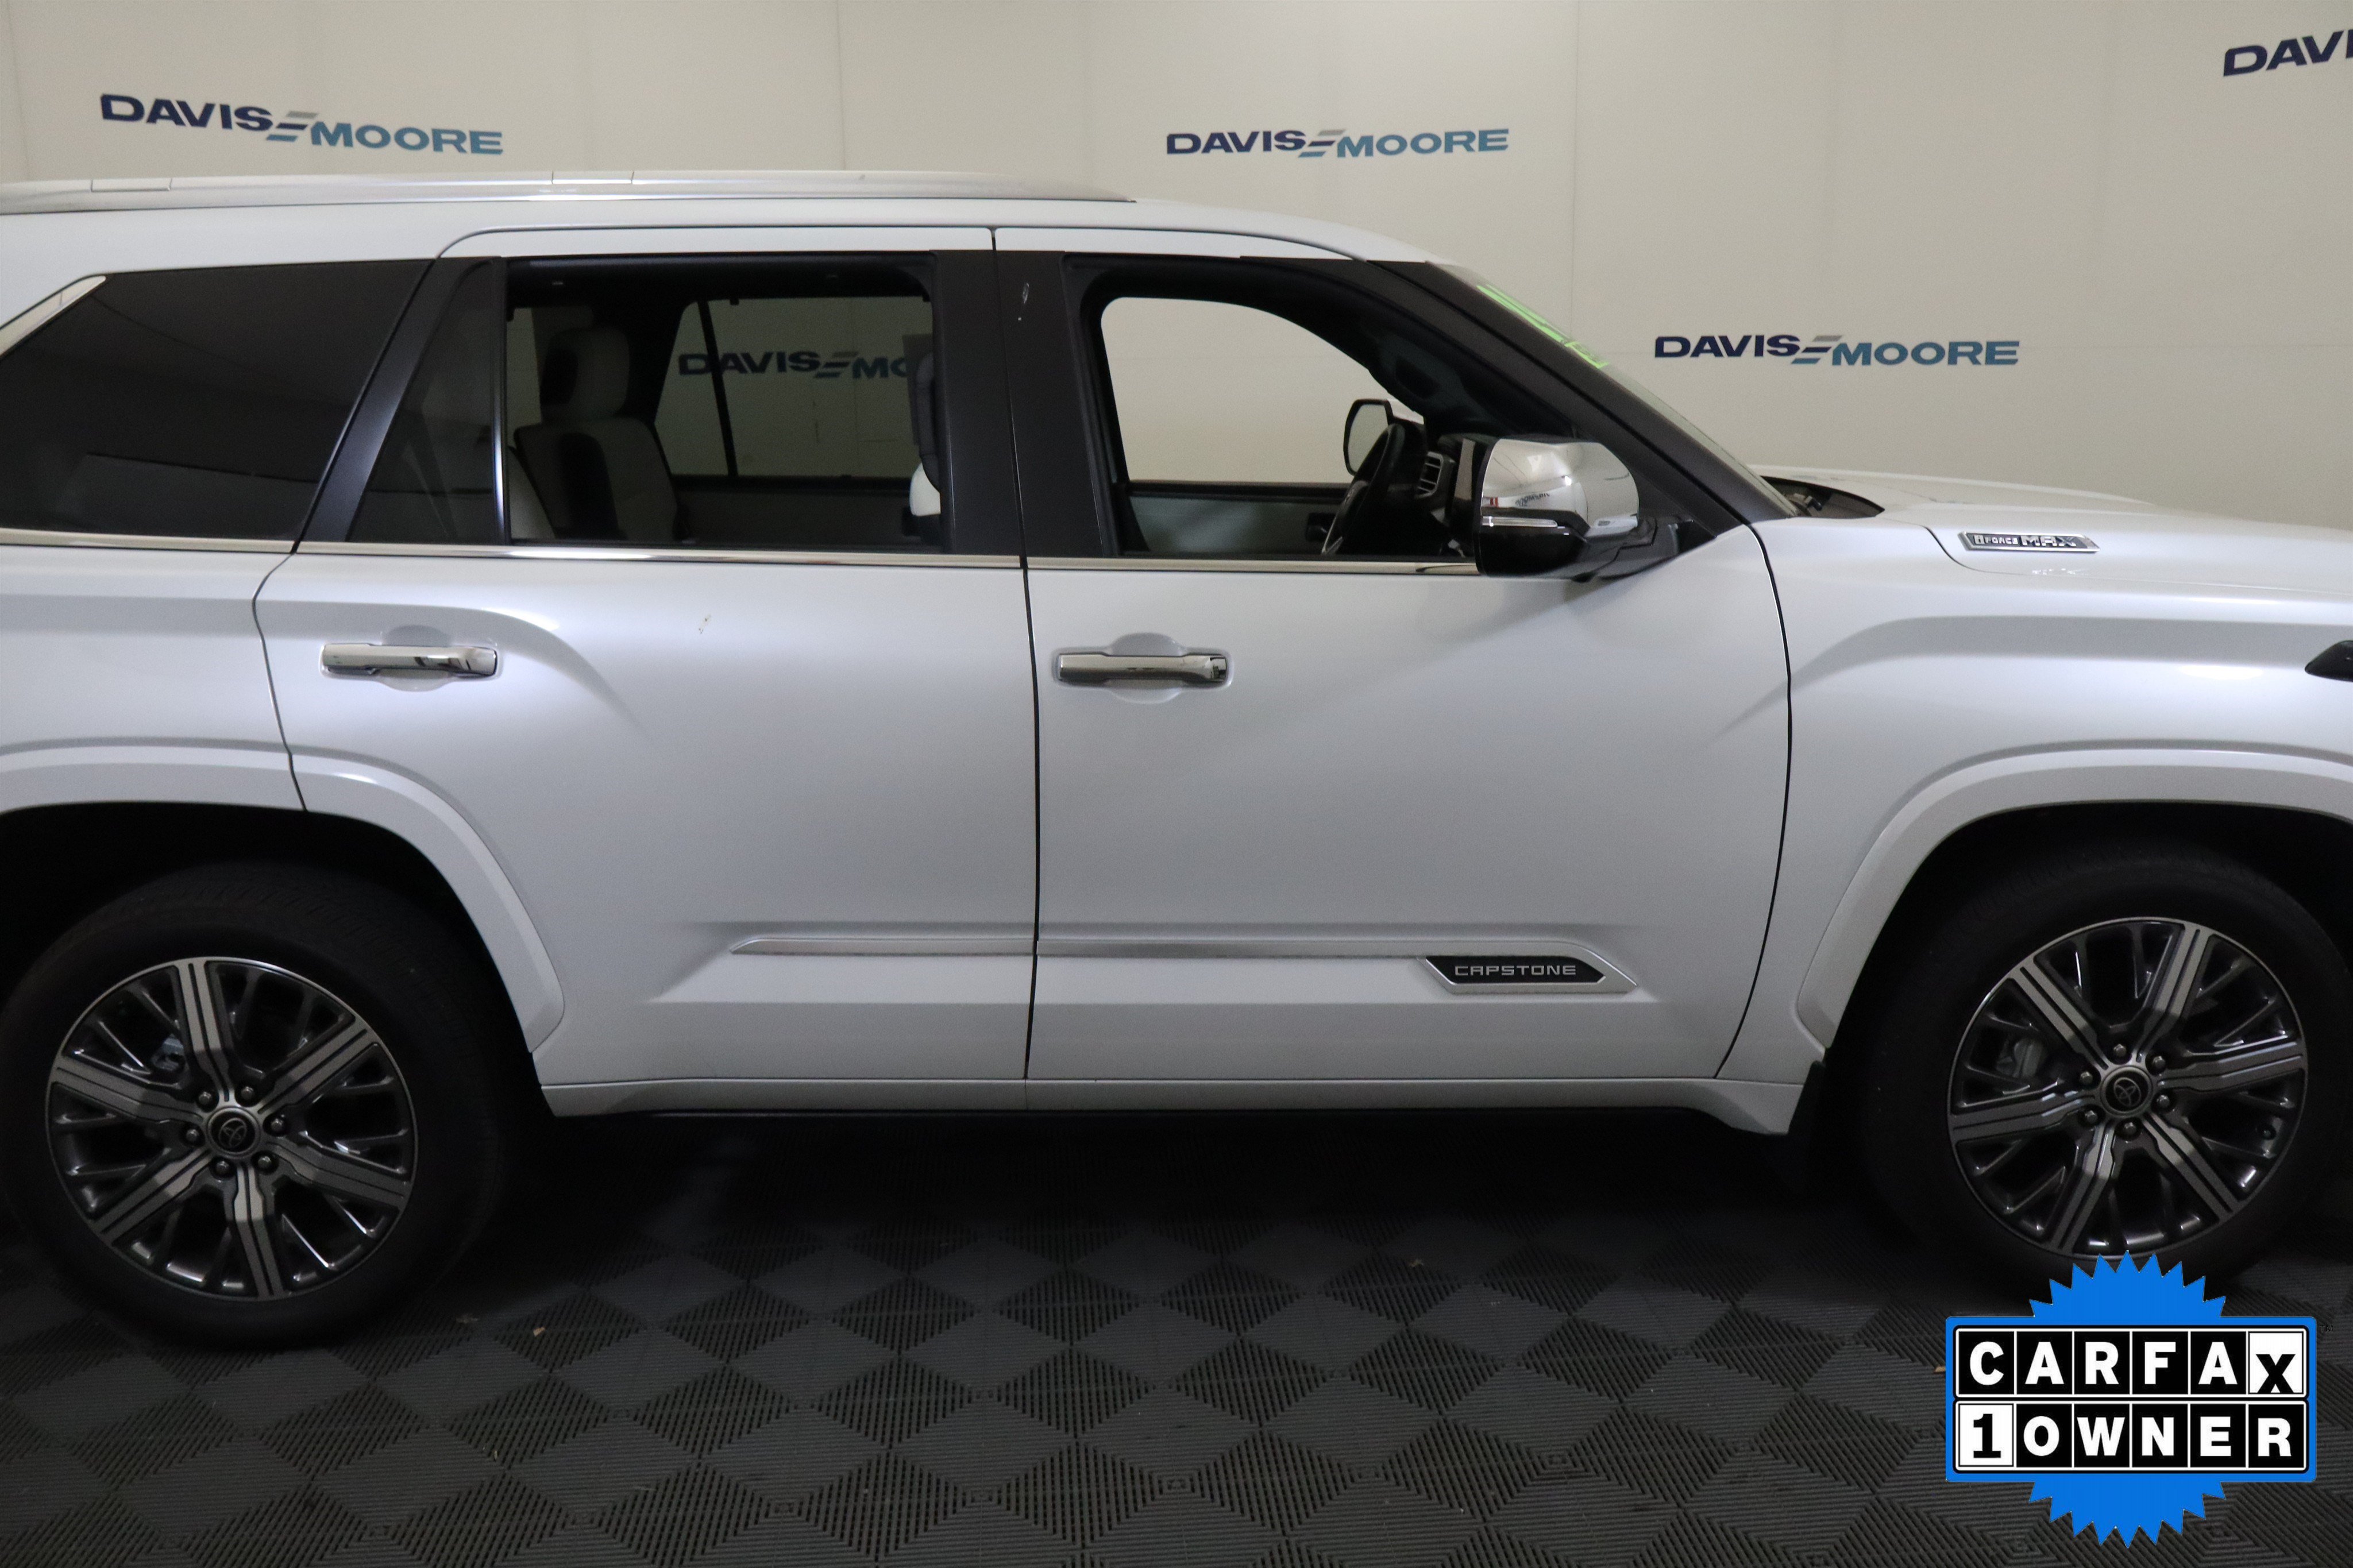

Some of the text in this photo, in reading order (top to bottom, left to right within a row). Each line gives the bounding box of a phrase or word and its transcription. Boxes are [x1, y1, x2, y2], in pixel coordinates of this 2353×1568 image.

[100, 94, 503, 156] DAVIS MOORE
[1167, 129, 1509, 158] DAVIS MOORE
[678, 351, 820, 376] DAVIS
[1654, 334, 2019, 366] DAVIS MOORE
[2020, 535, 2077, 547] MAX
[1455, 965, 1576, 976] CAPSTONE
